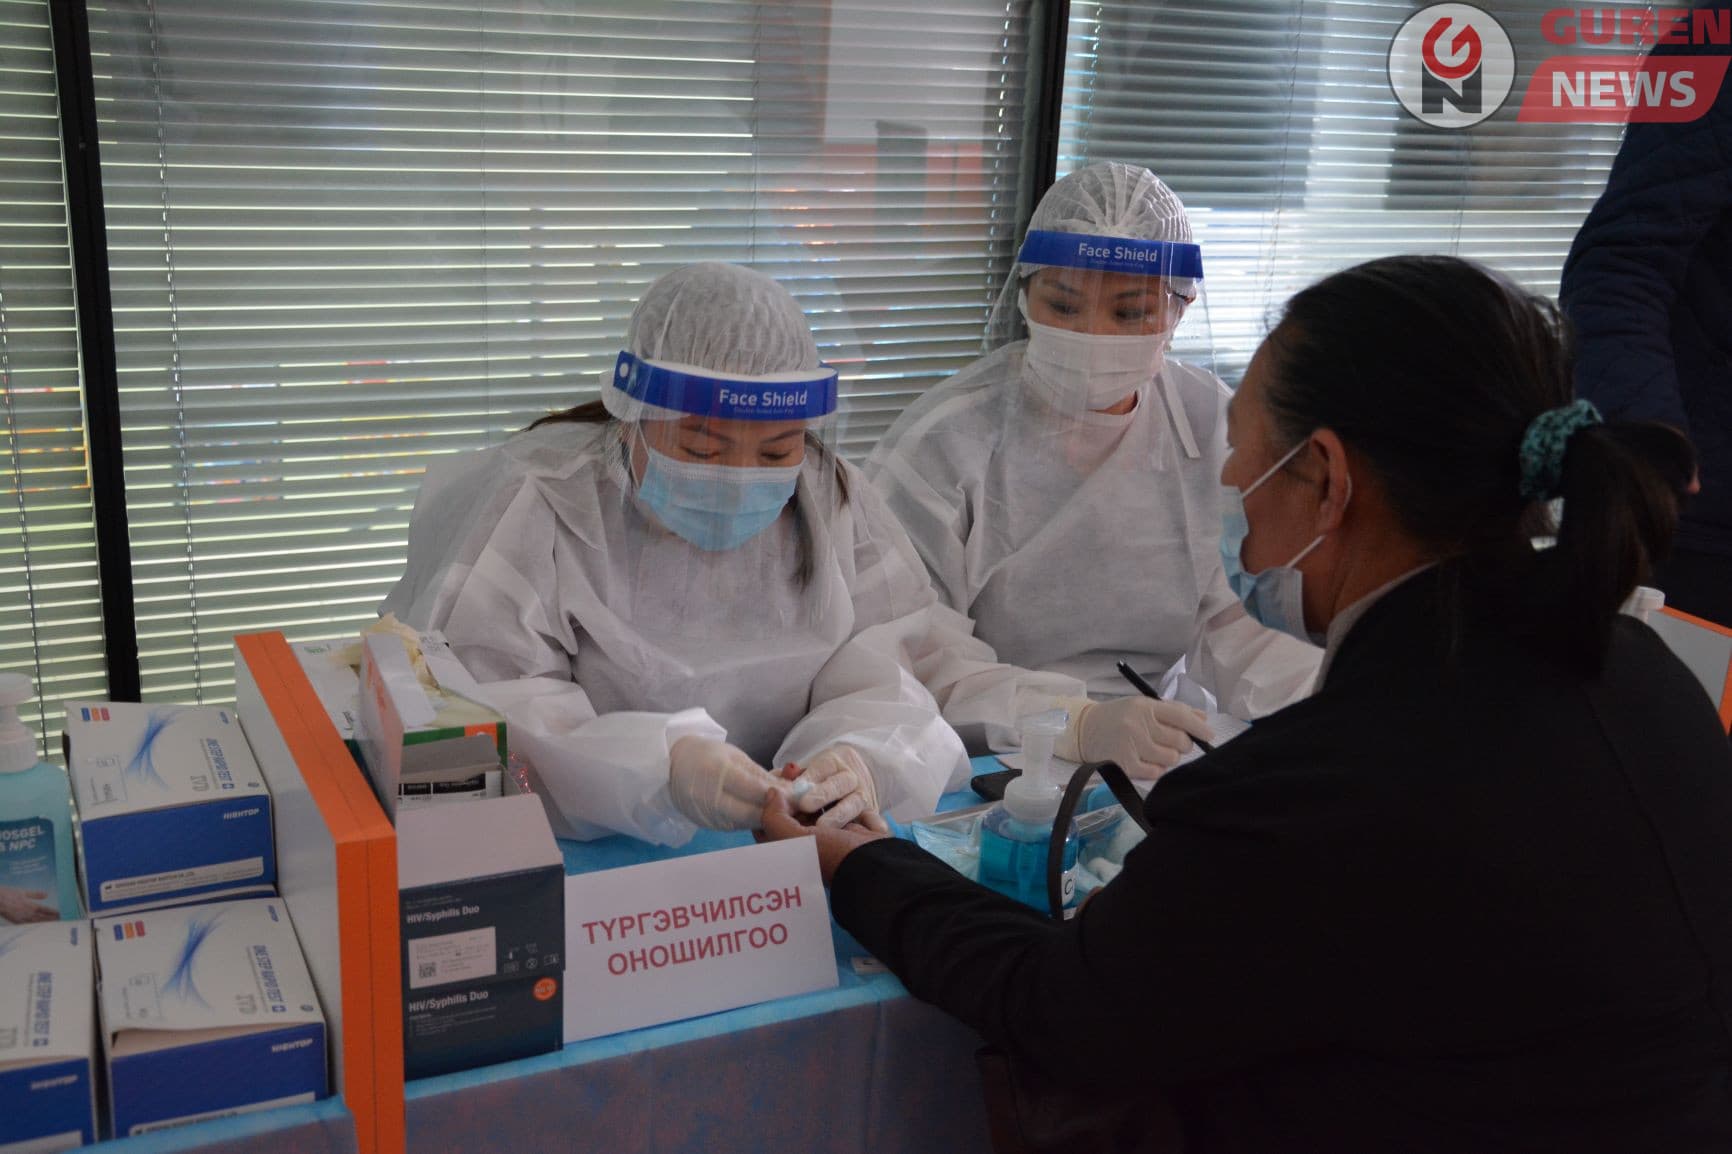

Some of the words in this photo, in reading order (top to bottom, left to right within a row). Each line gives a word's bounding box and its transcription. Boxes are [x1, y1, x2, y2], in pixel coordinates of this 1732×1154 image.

[1078, 242, 1111, 258] Face
[1114, 246, 1158, 263] Shield
[719, 389, 758, 406] Face
[762, 389, 808, 407] Shield
[406, 908, 460, 924] HIV/Syphilis
[462, 904, 480, 916] Duo
[582, 886, 802, 945] ТҮРГЭВЧИЛСЭН
[607, 922, 788, 976] ОНОШИЛГОО
[408, 995, 468, 1013] HIV/Syphilis
[469, 989, 489, 1003] Duo
